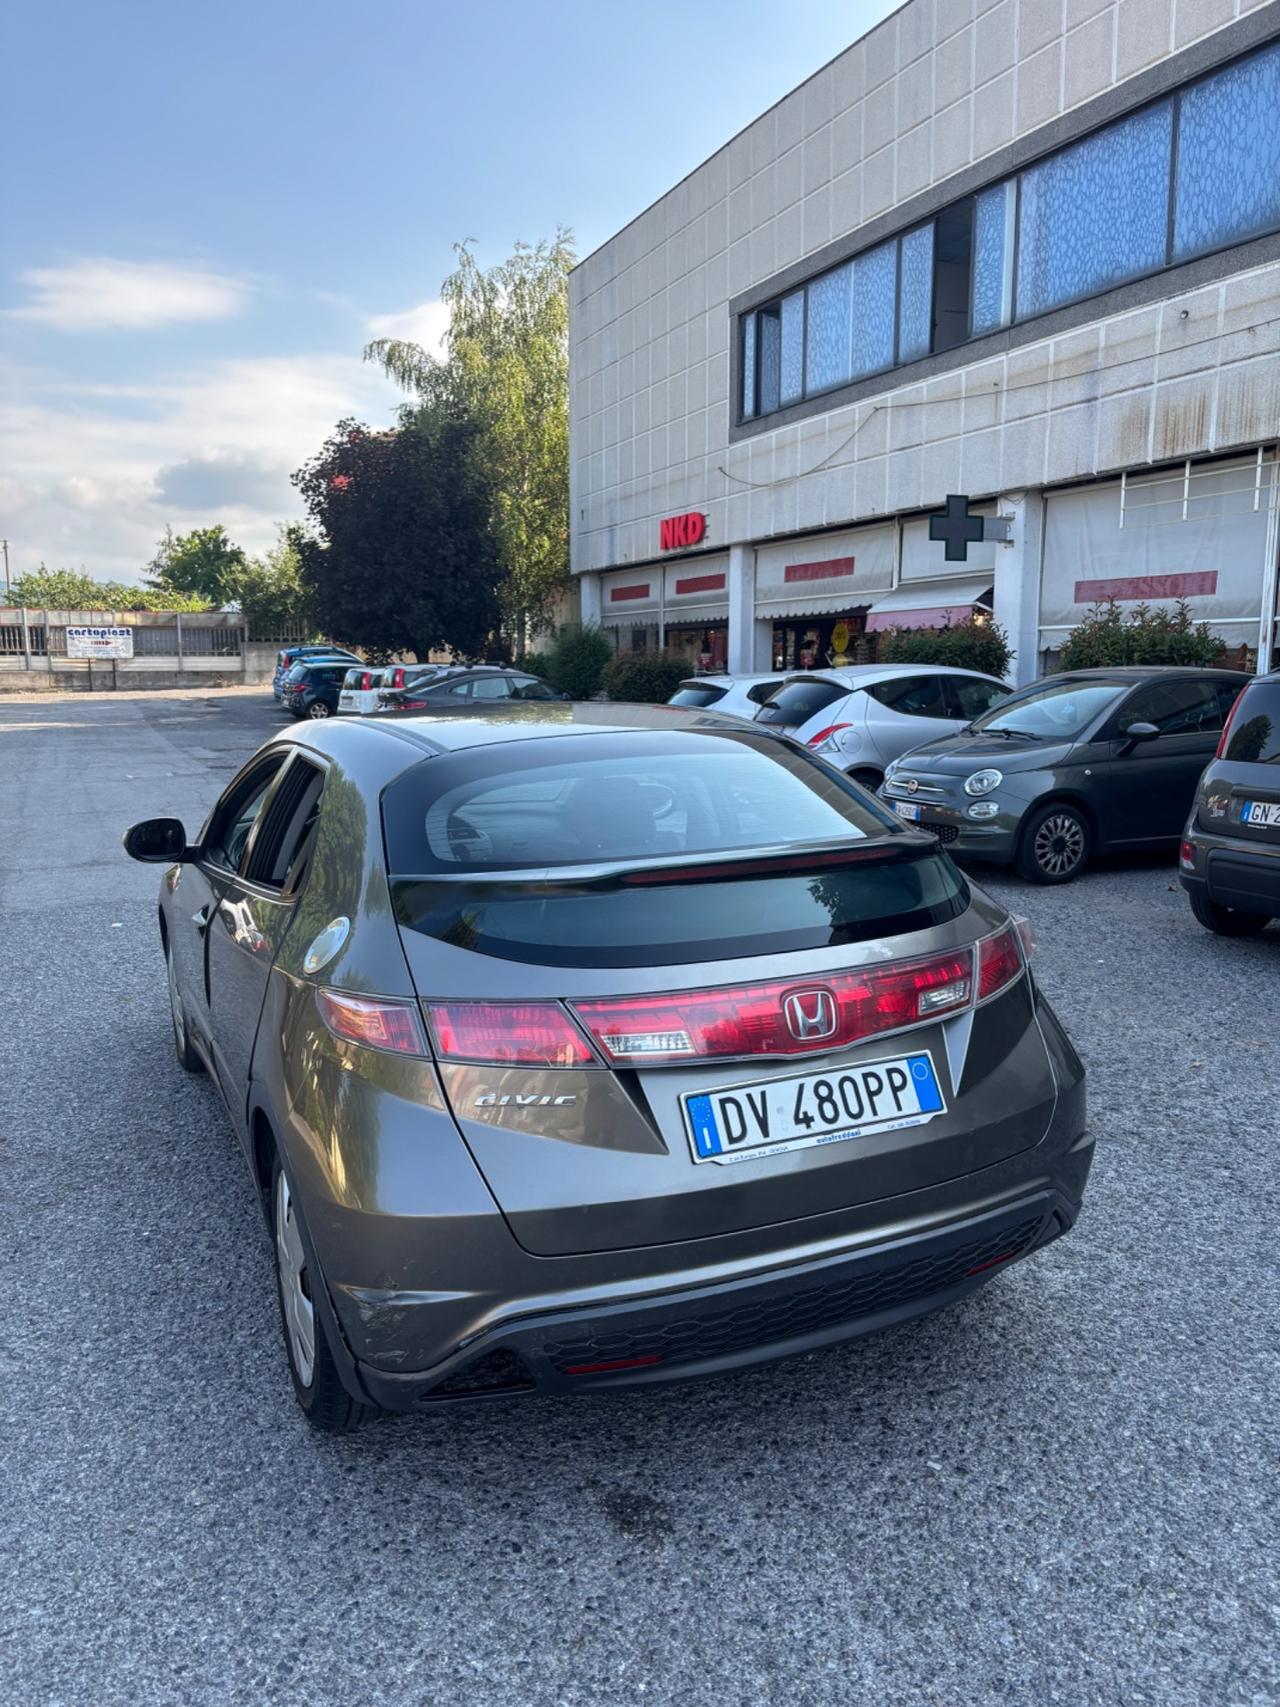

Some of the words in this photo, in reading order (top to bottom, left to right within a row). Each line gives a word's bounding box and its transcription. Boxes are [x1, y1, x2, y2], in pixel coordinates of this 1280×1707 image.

[660, 512, 705, 550] NKD
[68, 628, 131, 639] cartoplast
[1251, 804, 1271, 821] GN
[474, 1094, 577, 1106] CIVIC
[718, 1090, 770, 1145] DV
[793, 1066, 908, 1130] 480PP
